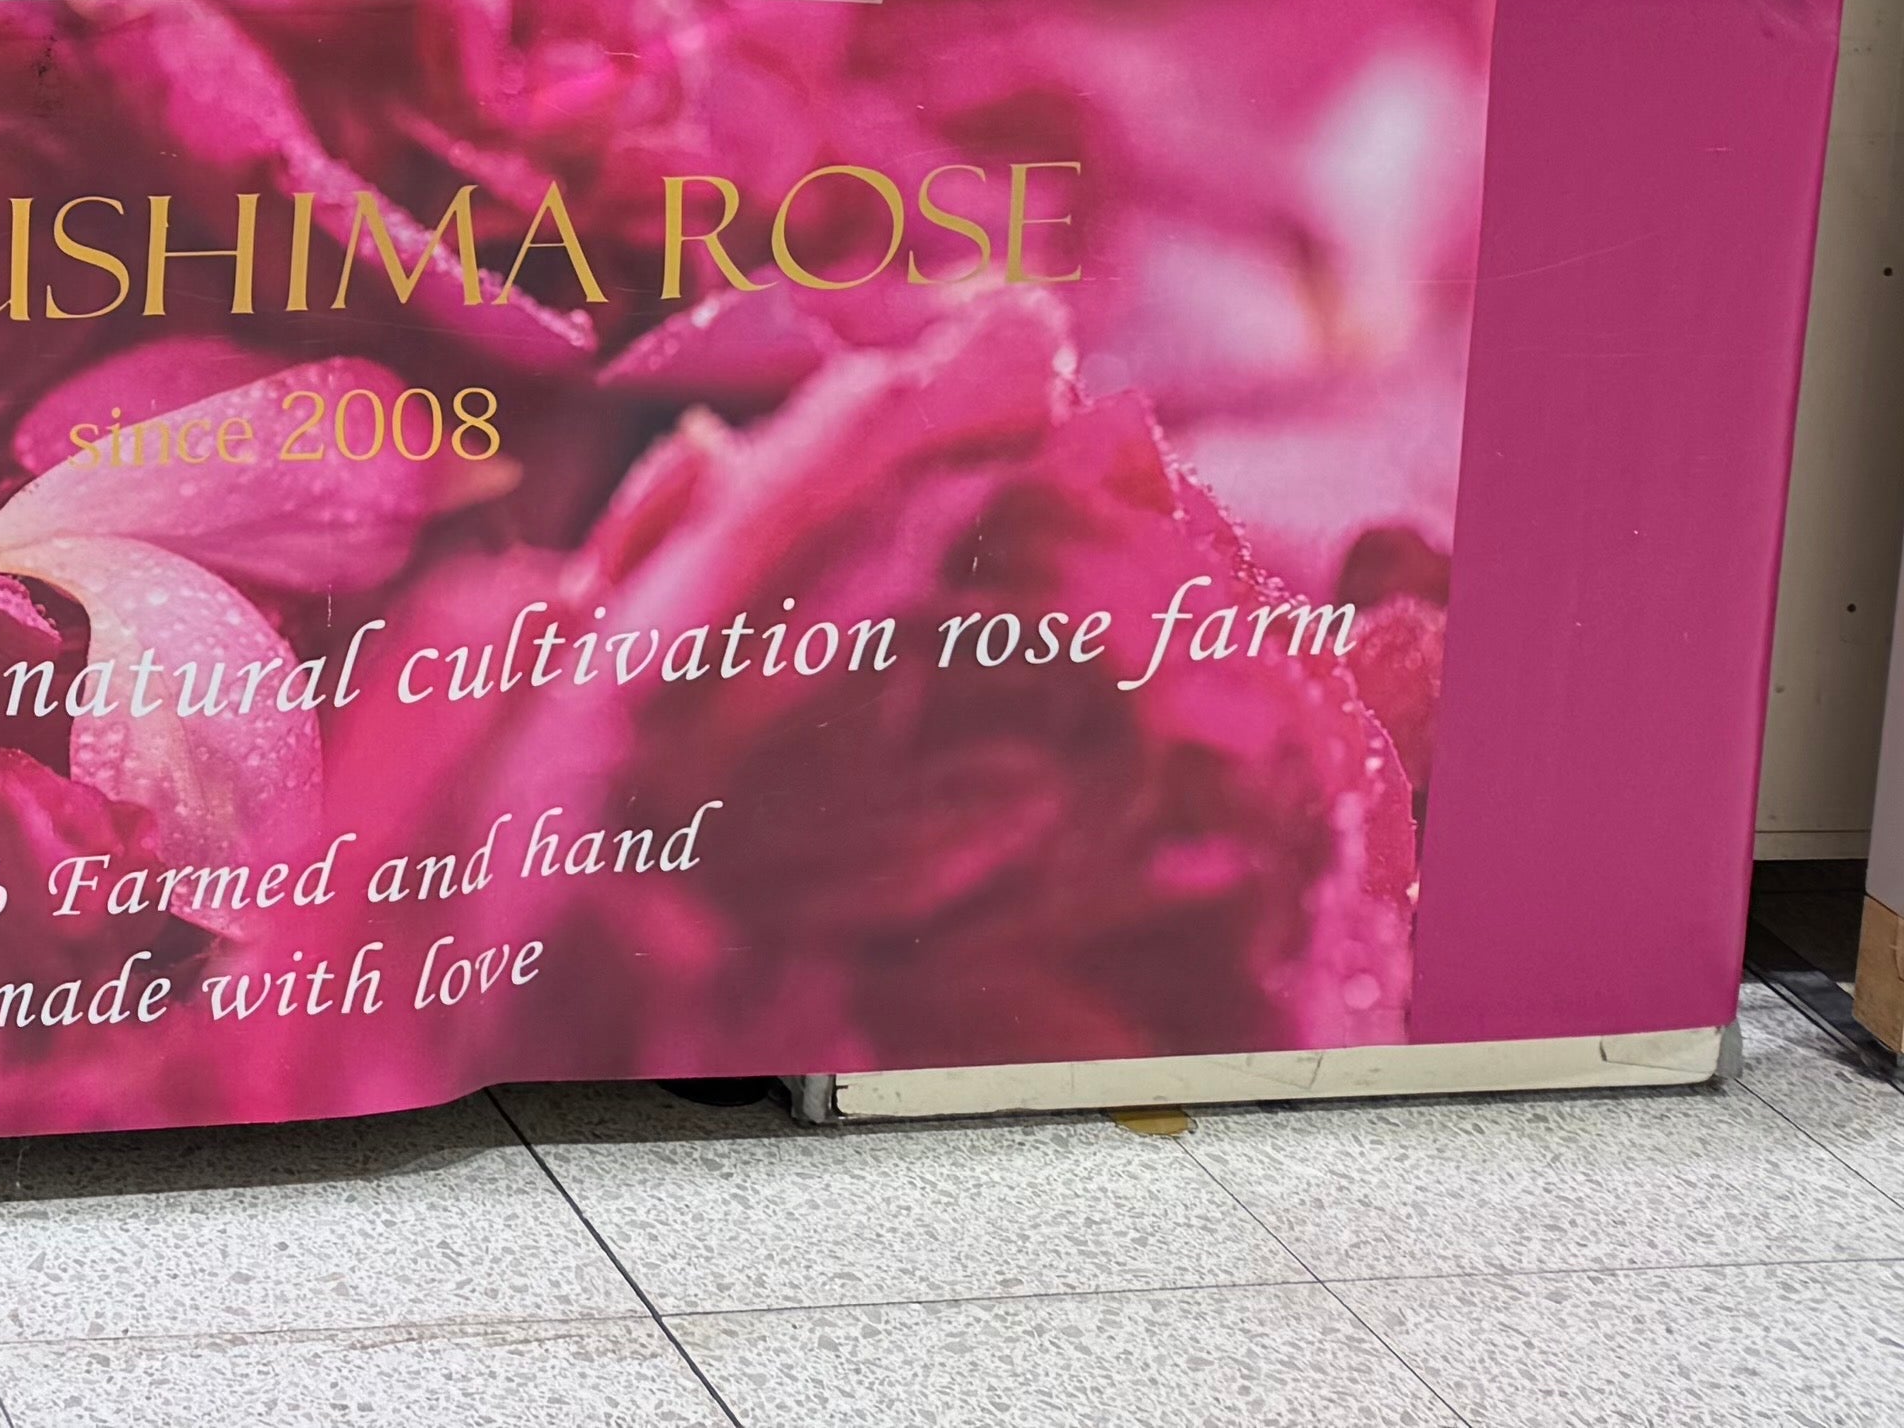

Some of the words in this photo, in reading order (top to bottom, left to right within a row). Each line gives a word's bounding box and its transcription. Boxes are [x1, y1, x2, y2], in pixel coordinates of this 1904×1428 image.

[660, 160, 1084, 300] ROSE
[68, 409, 254, 471] since
[278, 385, 502, 464] 2008
[3, 618, 387, 719] natural
[396, 601, 899, 708] cultivation
[933, 605, 1115, 672] rose
[1117, 575, 1359, 693] farm
[46, 832, 357, 920] Farmed
[366, 813, 513, 906] and
[519, 799, 724, 881] hand
[200, 940, 385, 1024] with
[411, 935, 545, 1013] love
